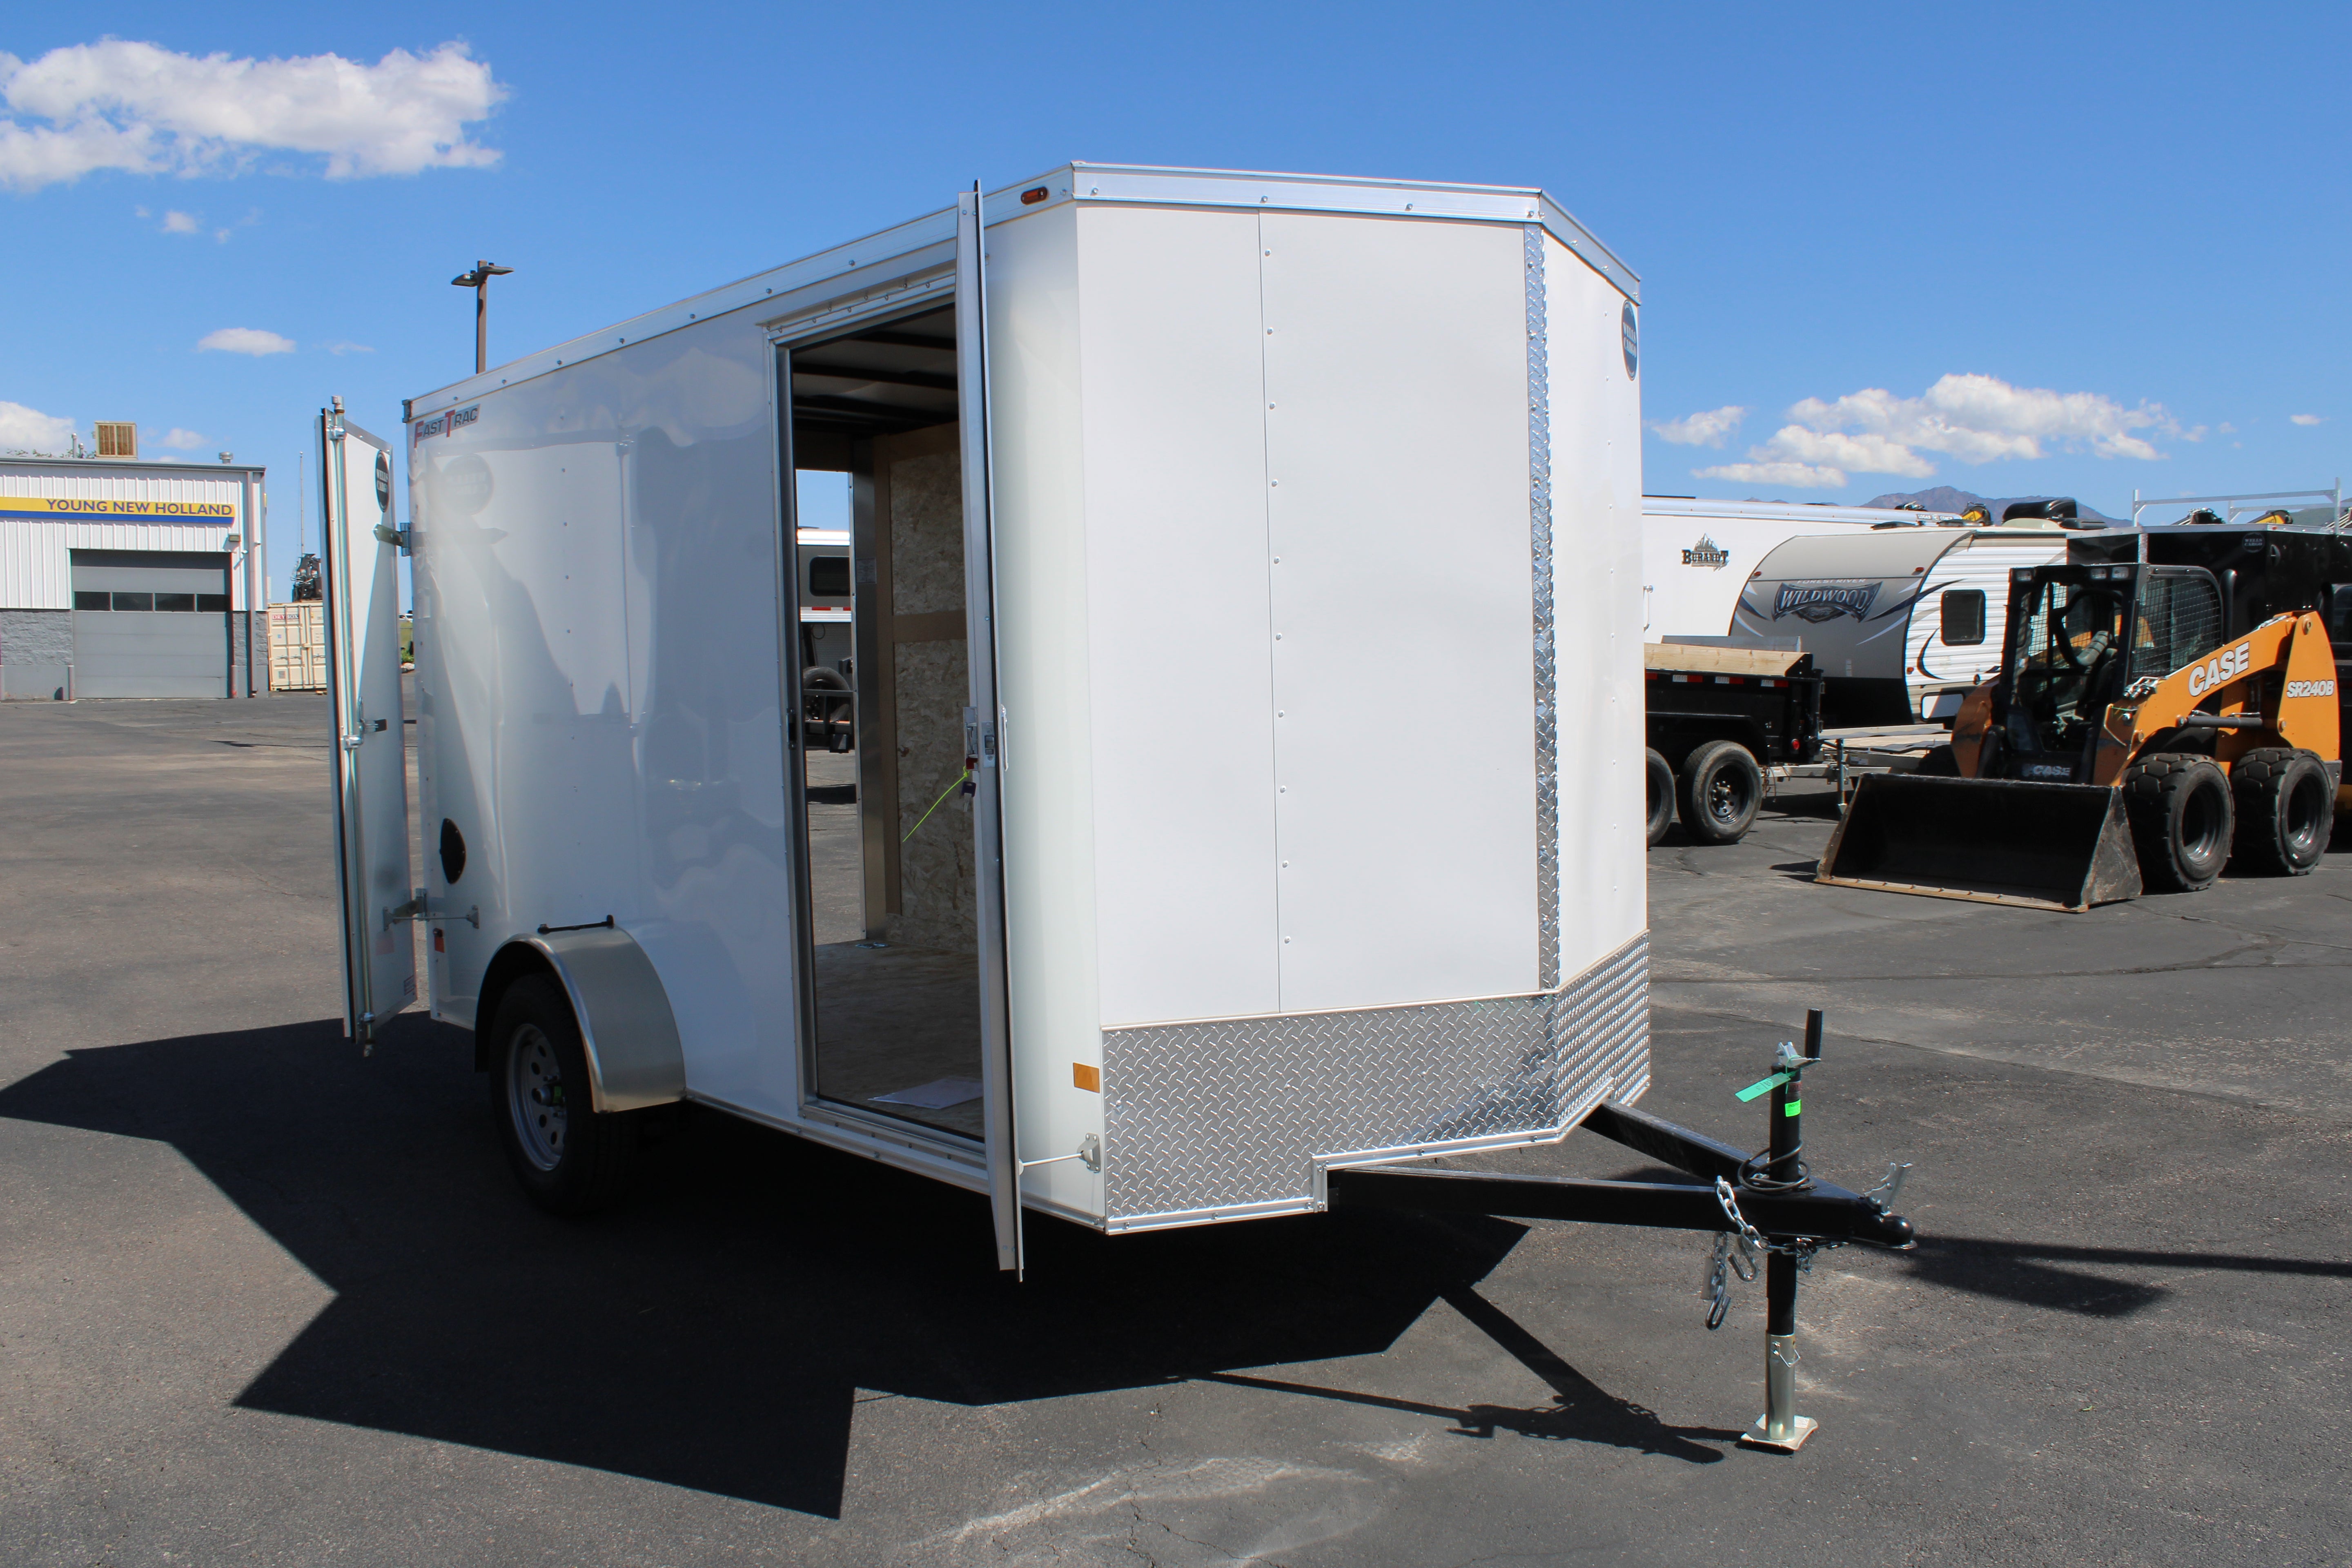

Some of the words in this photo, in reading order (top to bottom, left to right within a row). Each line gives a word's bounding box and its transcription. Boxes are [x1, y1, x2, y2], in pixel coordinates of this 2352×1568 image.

[414, 419, 444, 449] FAST
[445, 408, 478, 438] TRAC
[46, 499, 107, 512] YOUNG
[114, 502, 150, 513] NEW
[156, 503, 232, 515] HOLLAND
[1682, 549, 1729, 565] BURANDT
[1780, 590, 1869, 610] WILDWOOD
[2188, 641, 2250, 697] CASE
[2287, 680, 2334, 698] SR240B
[2033, 765, 2070, 776] CASE
